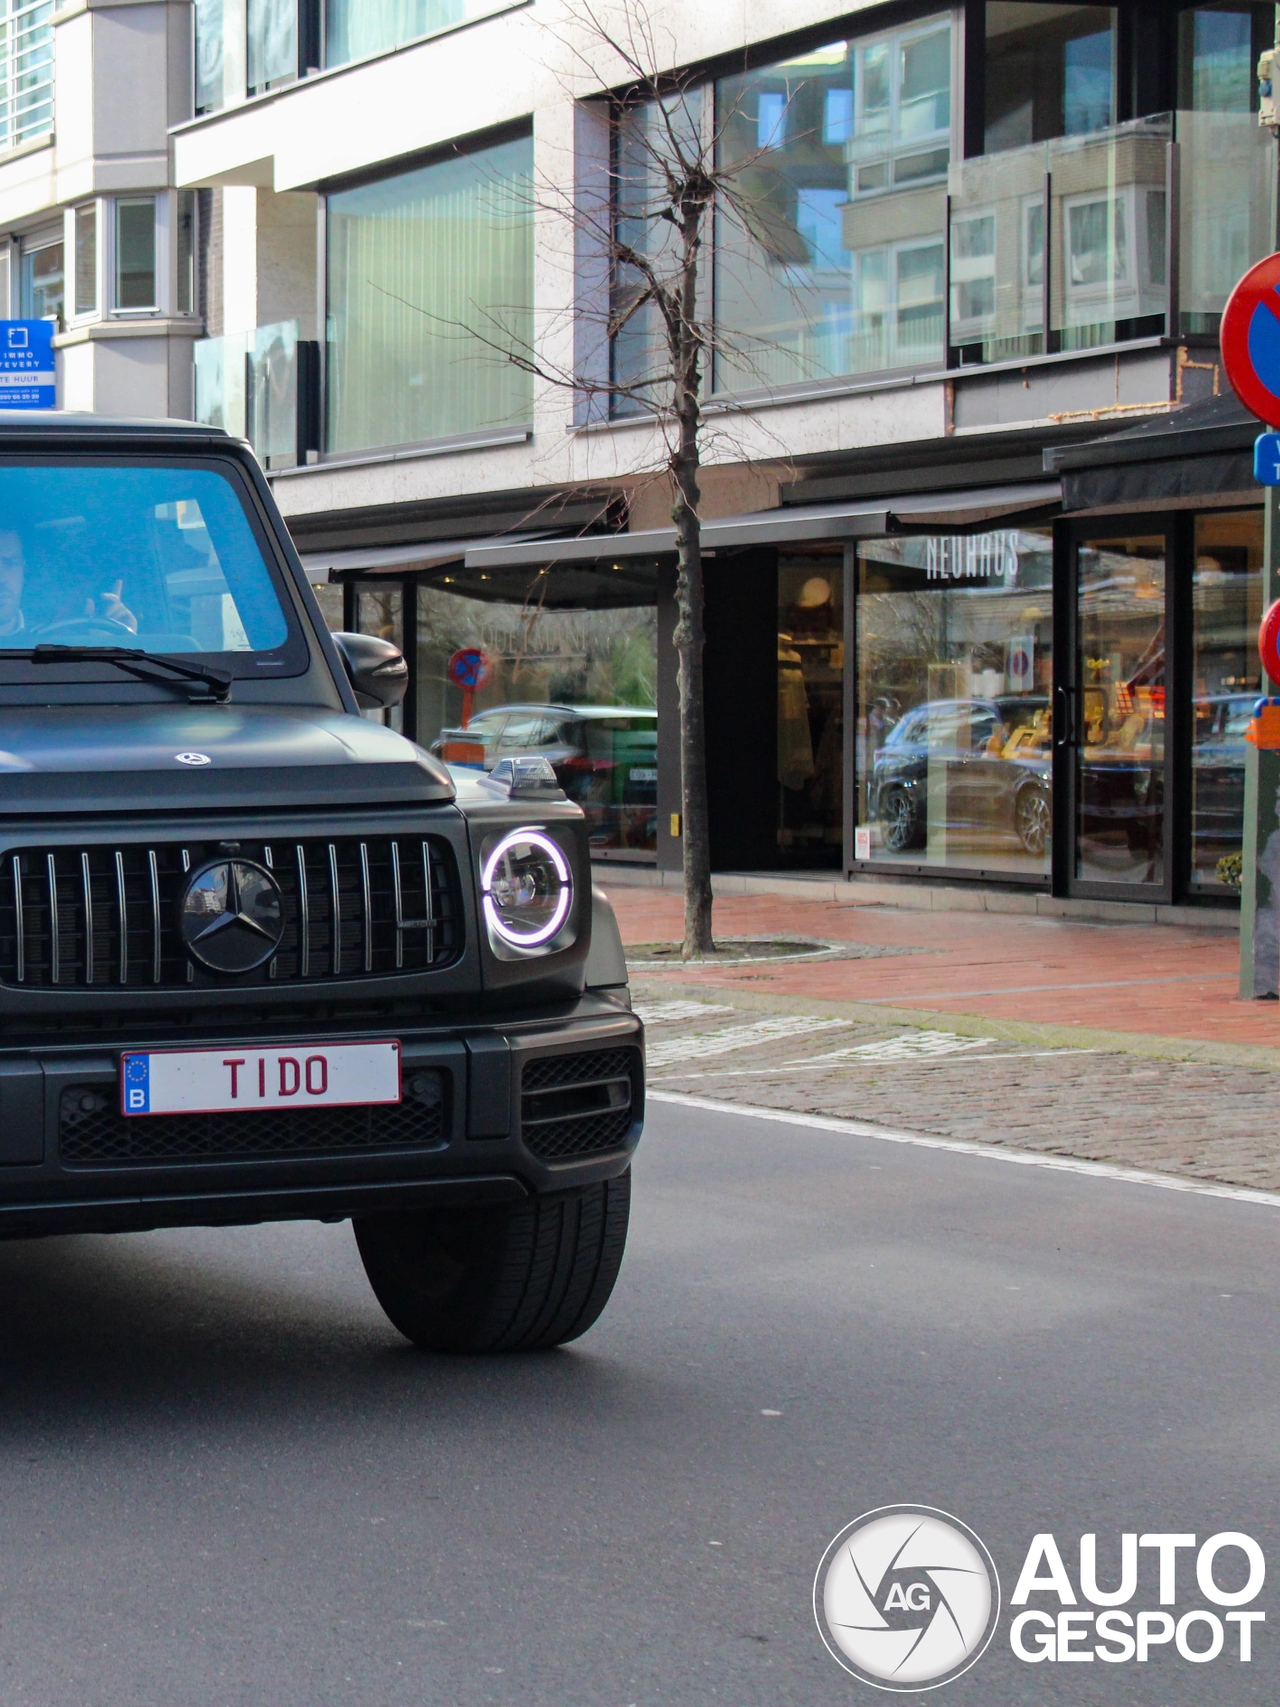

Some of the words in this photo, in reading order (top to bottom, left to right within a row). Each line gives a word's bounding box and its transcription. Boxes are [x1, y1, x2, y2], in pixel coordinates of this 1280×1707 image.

[927, 531, 1019, 580] NEUHAUS
[223, 1055, 328, 1098] TIDO
[129, 1089, 146, 1108] B
